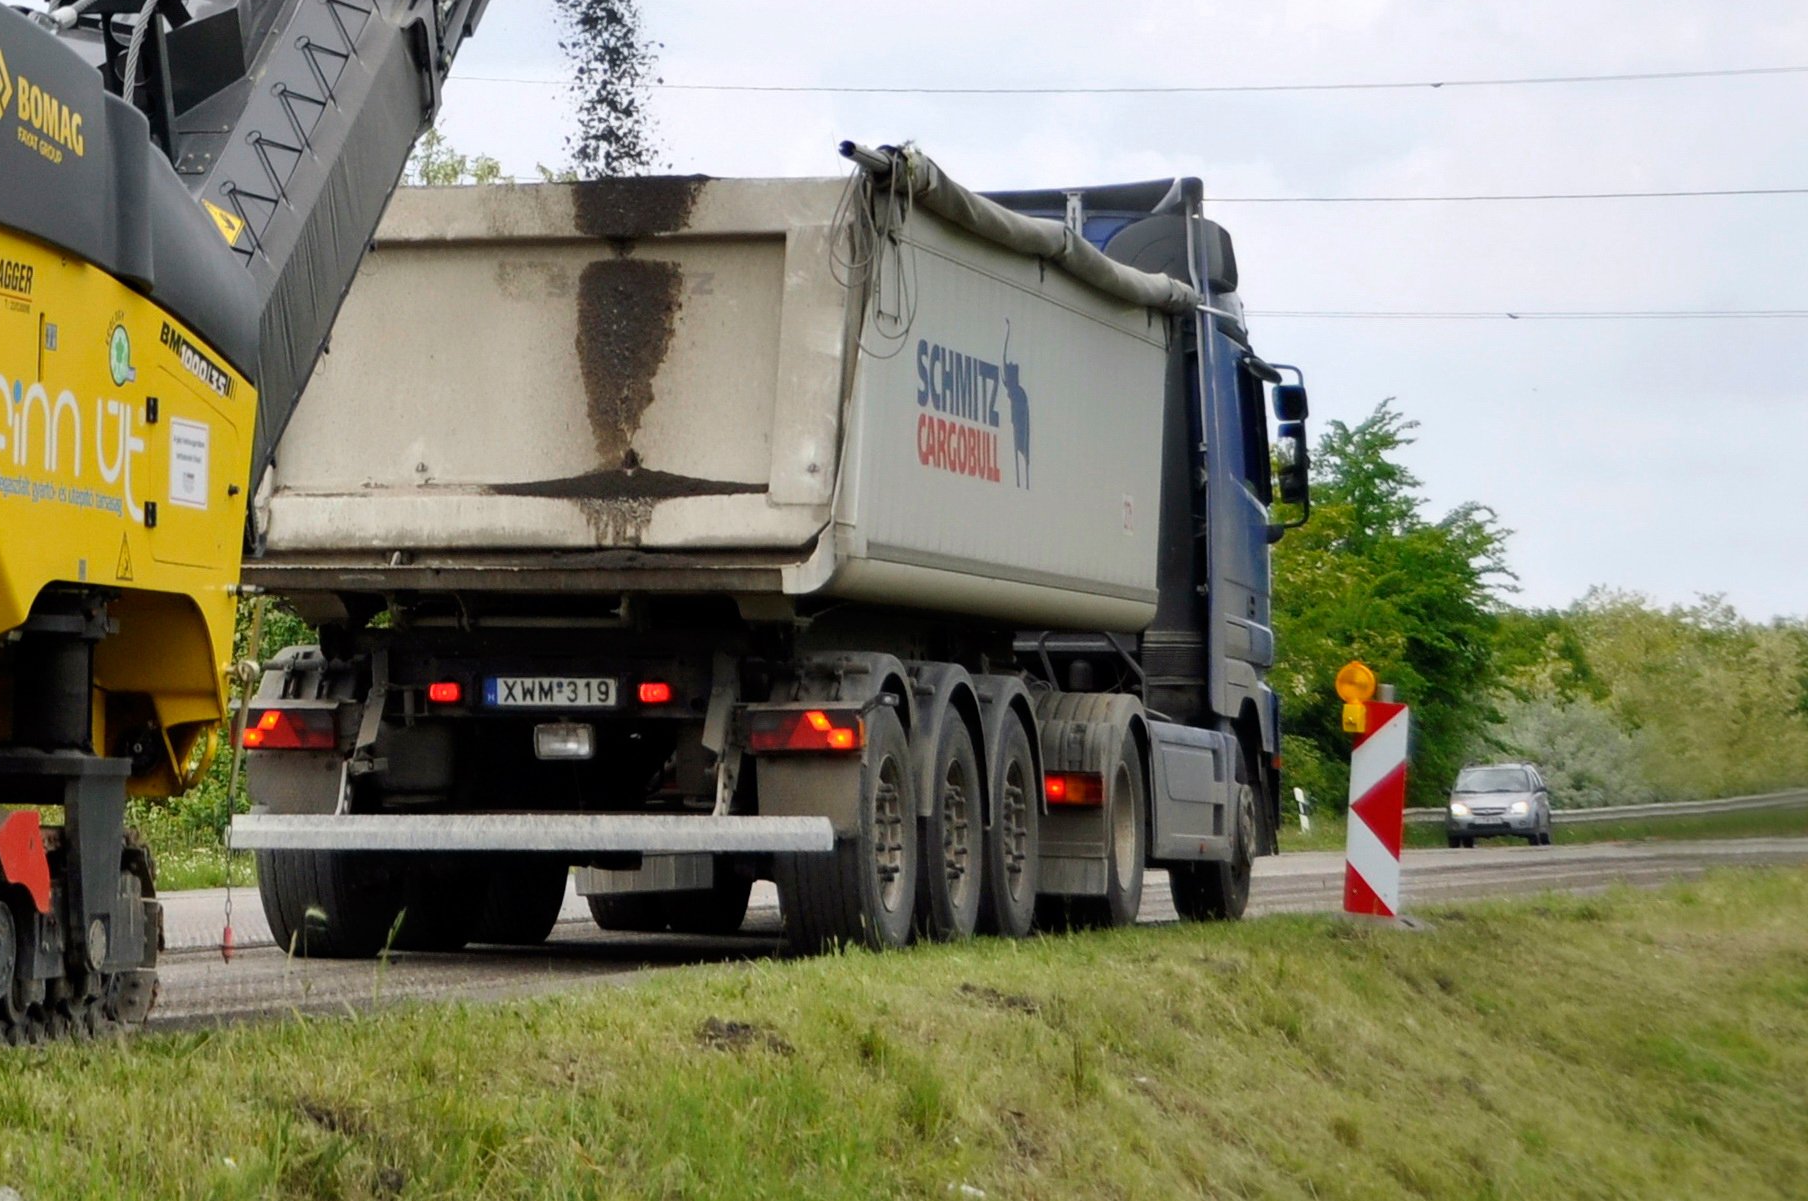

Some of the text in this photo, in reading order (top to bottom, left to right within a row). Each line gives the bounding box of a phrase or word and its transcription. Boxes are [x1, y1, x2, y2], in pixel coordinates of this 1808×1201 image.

[18, 75, 84, 157] BOMAG
[917, 338, 1000, 428] SCHMITZ
[917, 413, 1000, 483] CARGOBULL
